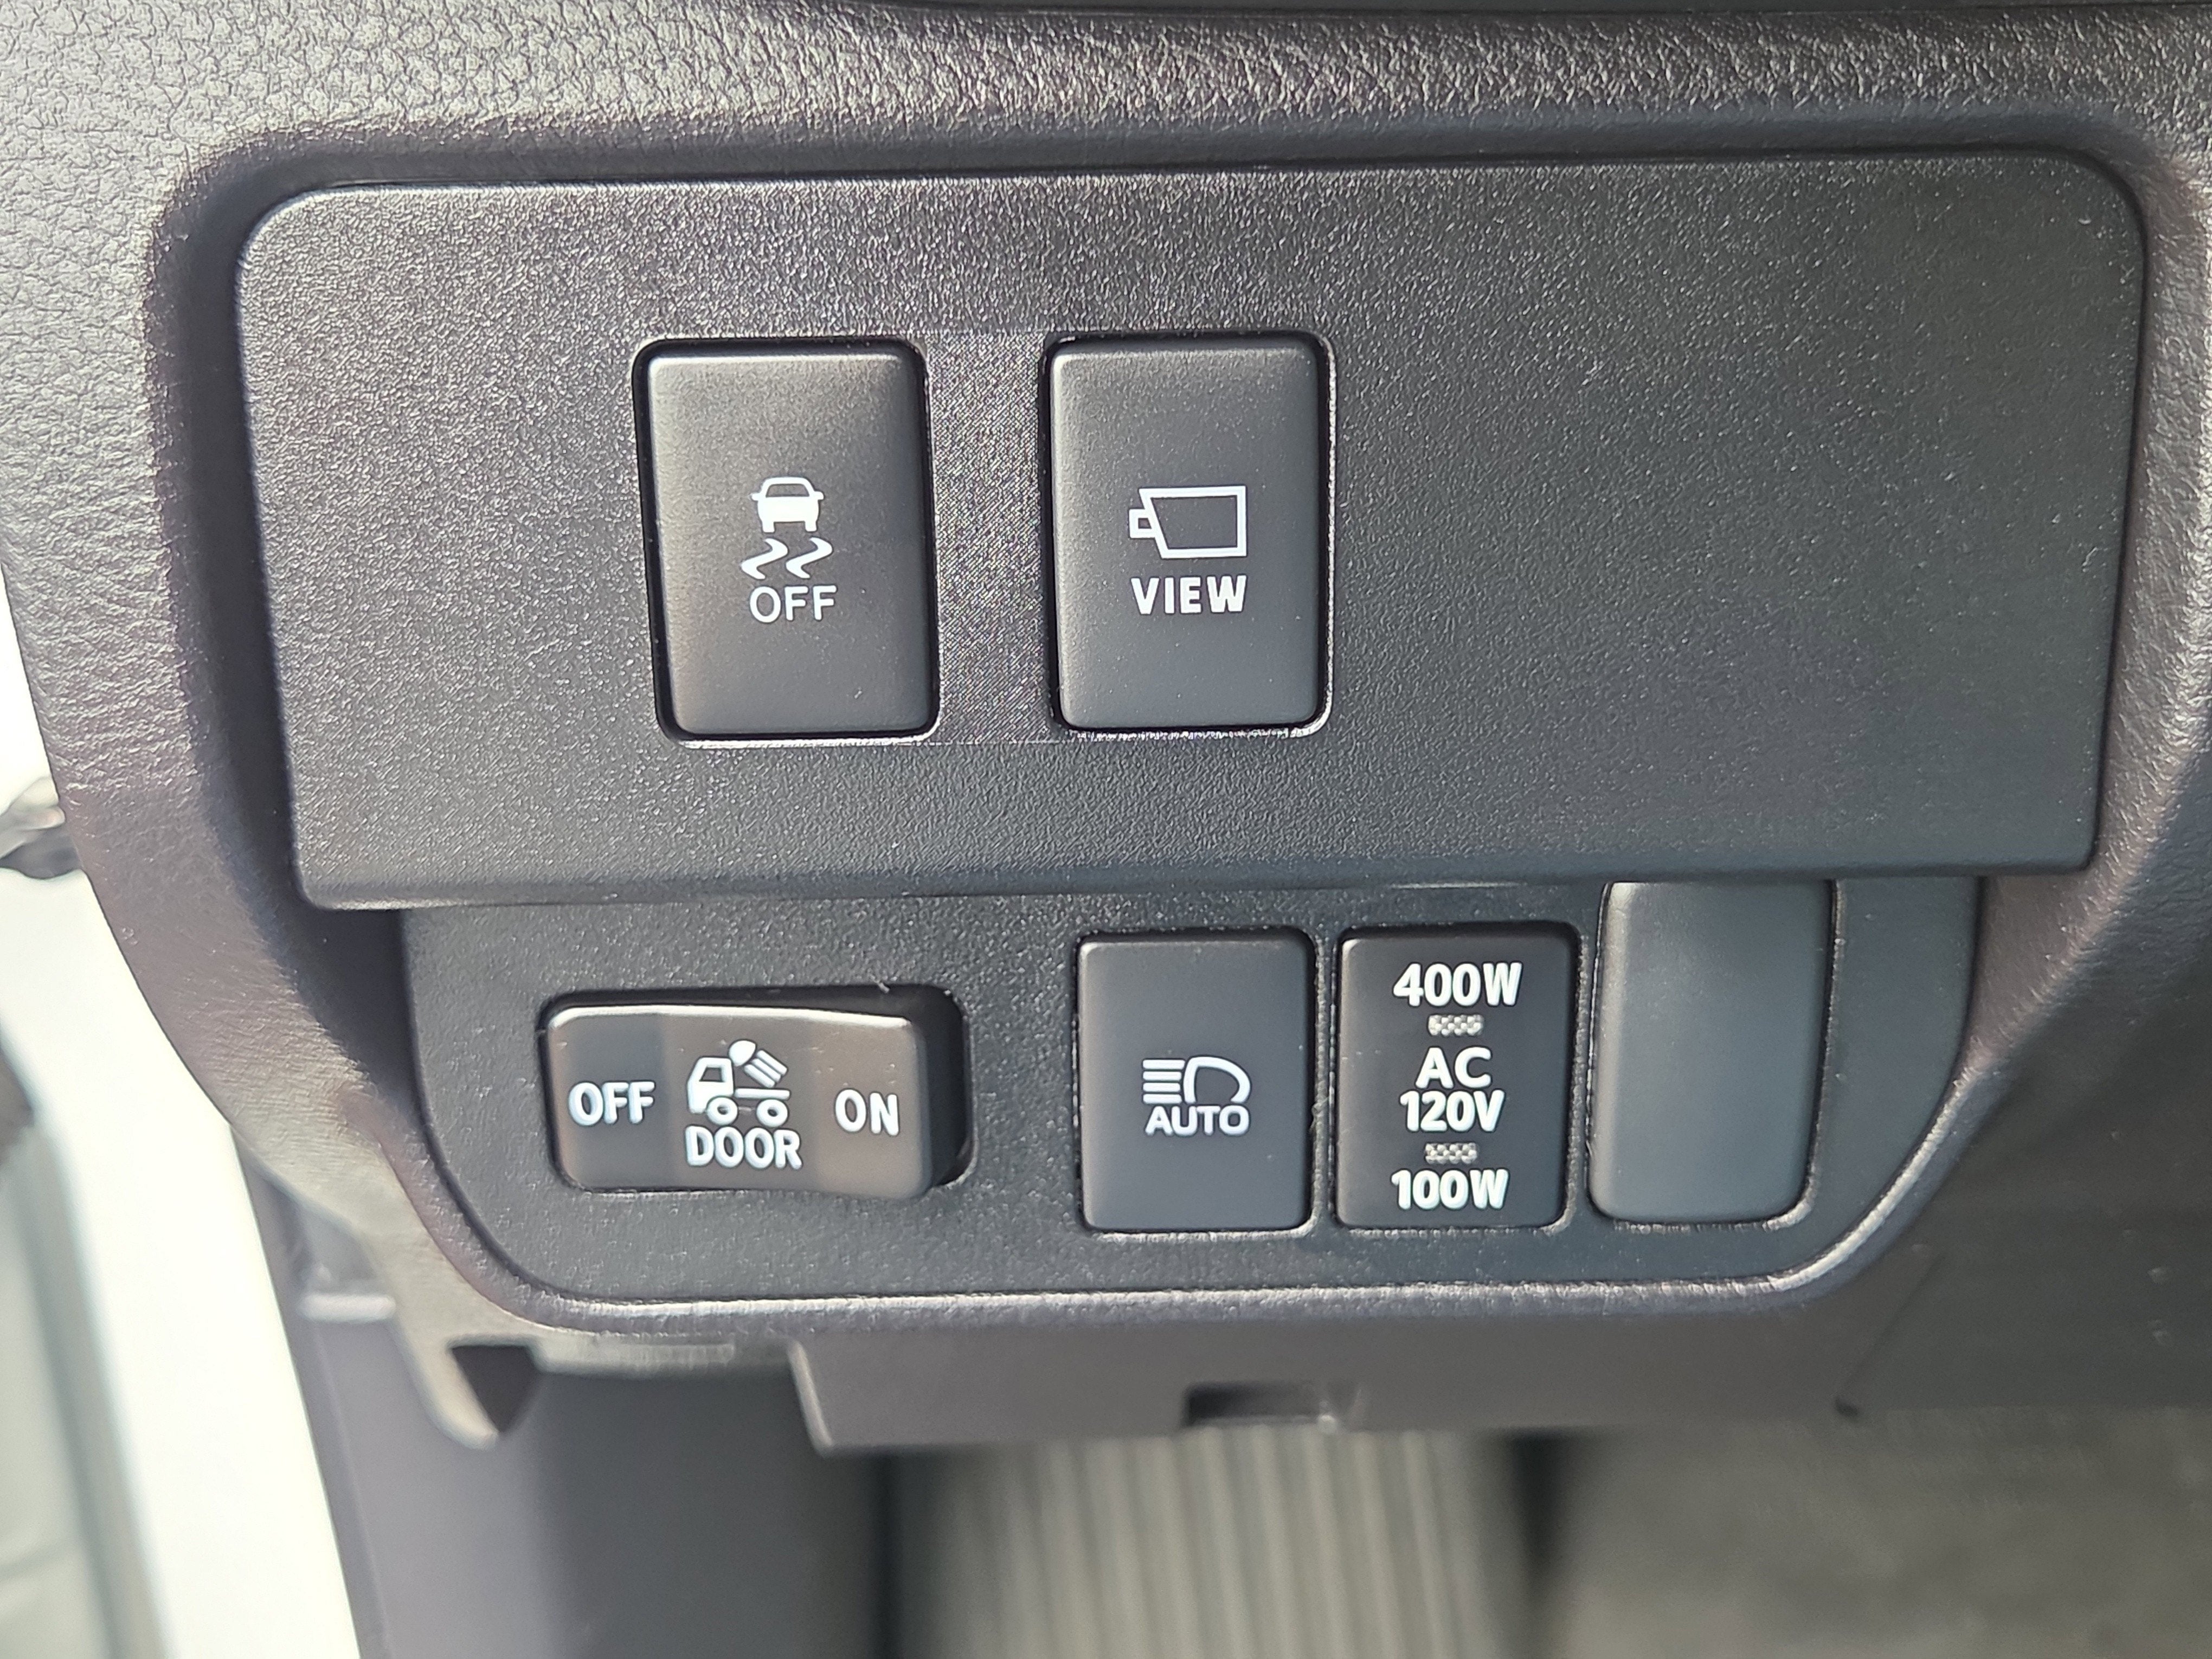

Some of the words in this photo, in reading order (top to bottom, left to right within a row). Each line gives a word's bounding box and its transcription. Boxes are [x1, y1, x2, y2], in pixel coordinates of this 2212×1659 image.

[750, 584, 837, 623] OFF
[1131, 575, 1246, 614] VIEW
[1394, 963, 1521, 1006] 400W
[1416, 1048, 1491, 1088] AC
[569, 1082, 654, 1125] OFF
[836, 1090, 899, 1135] ON
[1144, 1105, 1249, 1134] AUTO
[1400, 1090, 1504, 1131] 120V
[686, 1127, 802, 1168] DOOR
[1392, 1169, 1508, 1210] 100W
